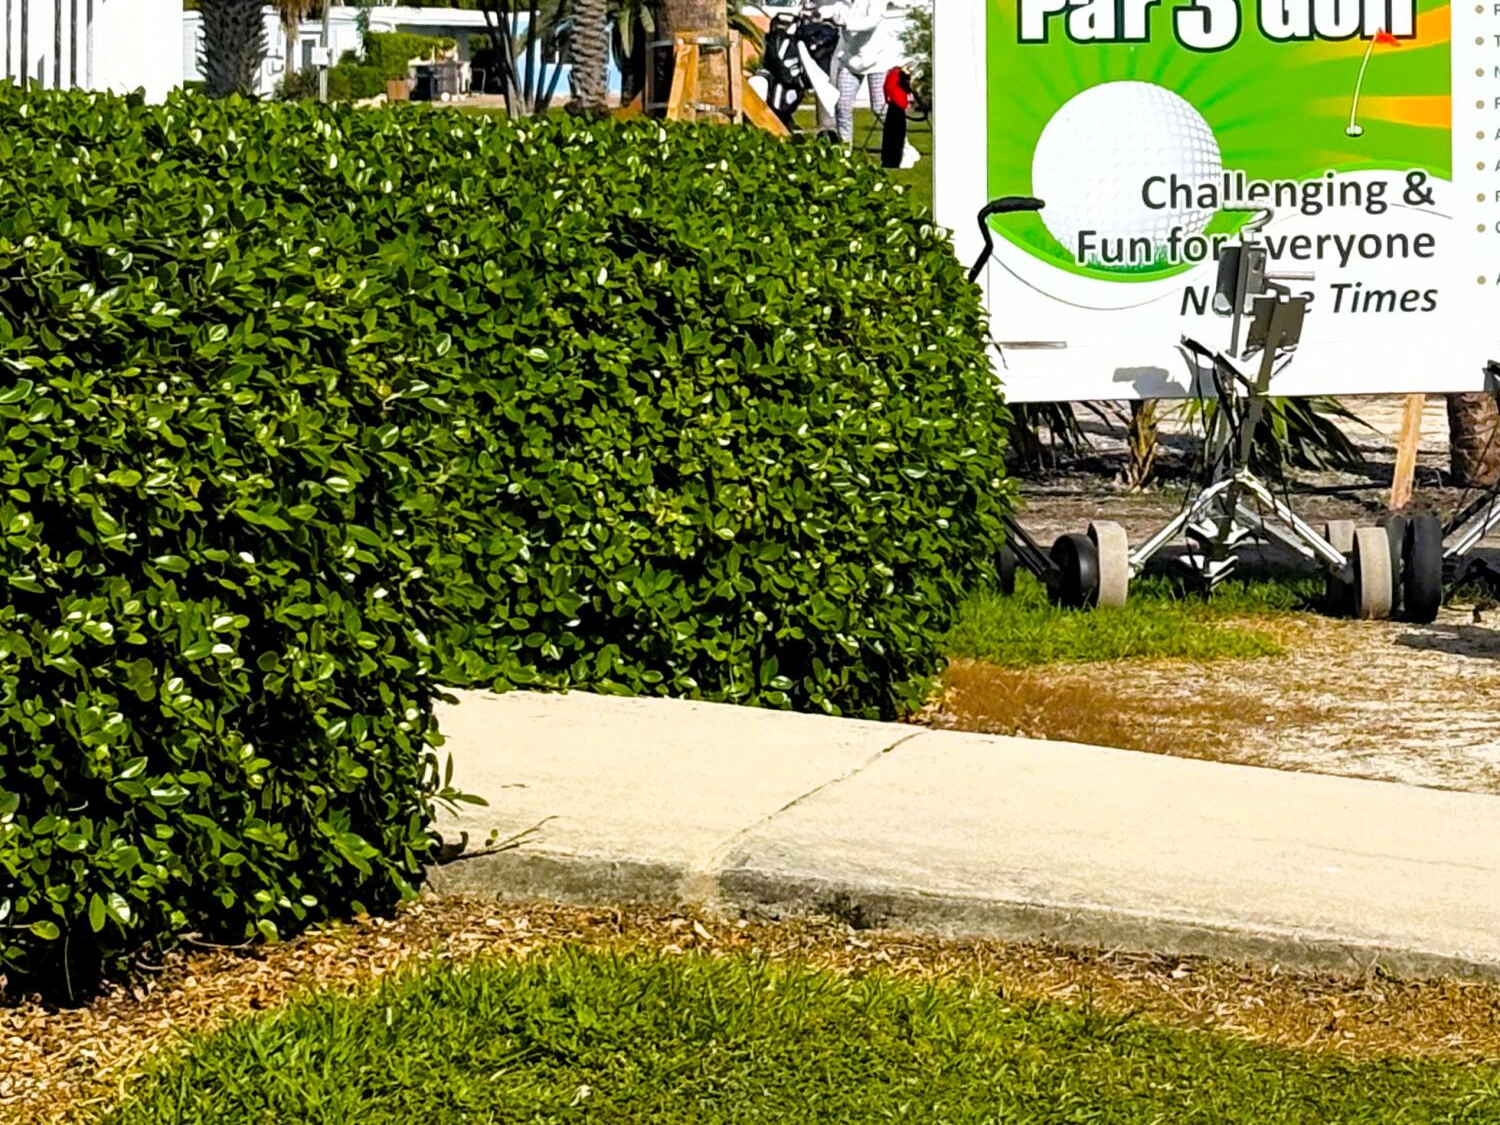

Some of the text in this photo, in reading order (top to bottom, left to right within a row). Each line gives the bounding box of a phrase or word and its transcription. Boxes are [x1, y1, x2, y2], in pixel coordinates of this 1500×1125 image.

[1141, 170, 1436, 216] Challenging &
[1077, 230, 1152, 263] Fun
[1166, 226, 1228, 262] for
[1329, 282, 1440, 315] Times
